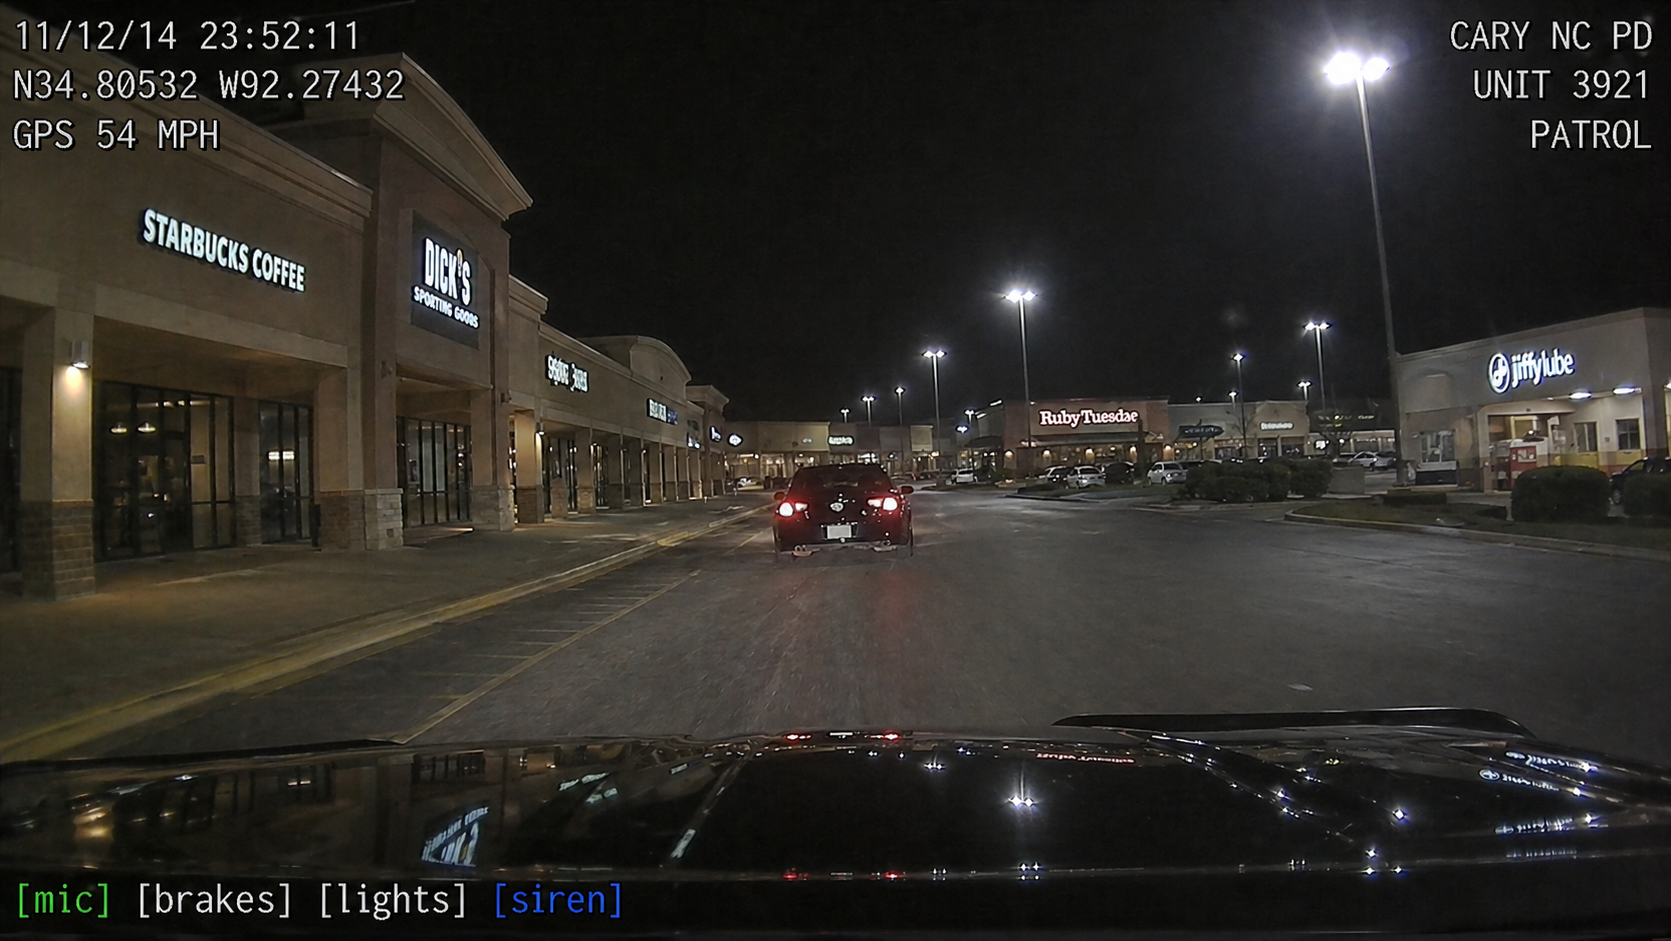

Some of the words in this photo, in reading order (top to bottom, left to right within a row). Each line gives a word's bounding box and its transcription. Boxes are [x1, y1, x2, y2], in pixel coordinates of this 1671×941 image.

[143, 208, 249, 274] STARBUCKS
[252, 248, 305, 292] COFFEE
[424, 237, 471, 306] DICK'S
[413, 285, 453, 317] SPORTING
[453, 305, 479, 329] GOODS
[1039, 410, 1080, 428] Ruby
